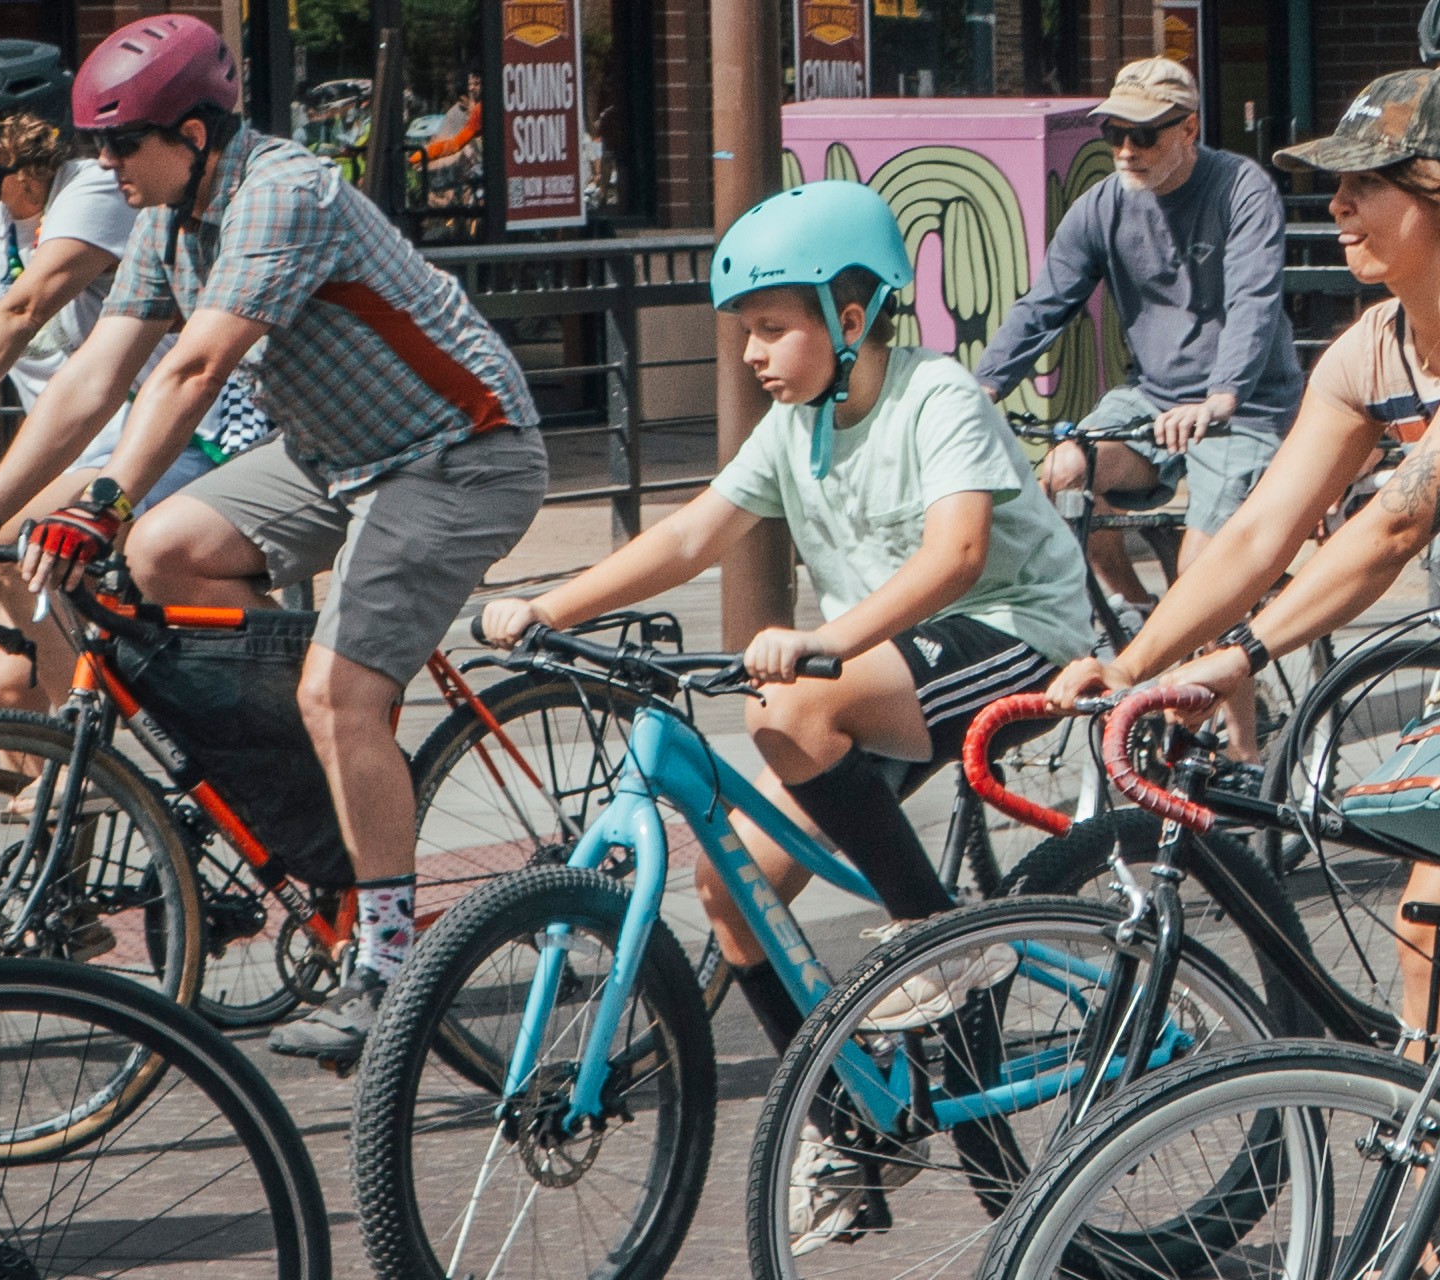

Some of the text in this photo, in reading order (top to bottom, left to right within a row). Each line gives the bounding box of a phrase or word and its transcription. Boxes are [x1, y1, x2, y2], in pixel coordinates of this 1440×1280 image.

[502, 62, 574, 113] COMING
[803, 60, 864, 100] COMING
[512, 114, 567, 165] SOON!
[720, 830, 818, 995] TREK
